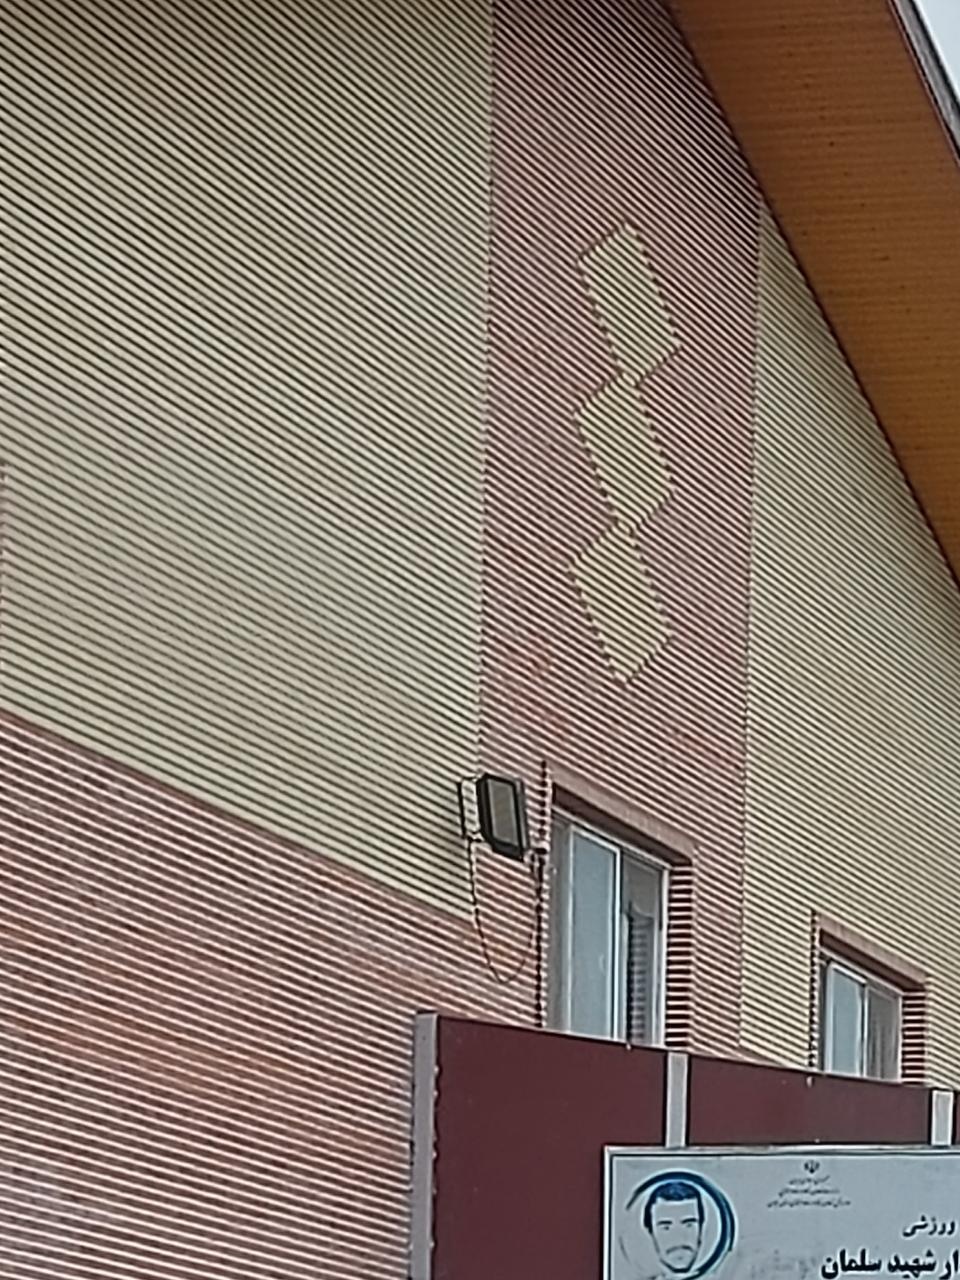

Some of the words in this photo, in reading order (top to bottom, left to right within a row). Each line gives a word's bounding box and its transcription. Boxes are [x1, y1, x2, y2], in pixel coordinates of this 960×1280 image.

[903, 1214, 956, 1237] ورزشی
[821, 1248, 882, 1280] سلمان
[887, 1249, 937, 1279] شهید
